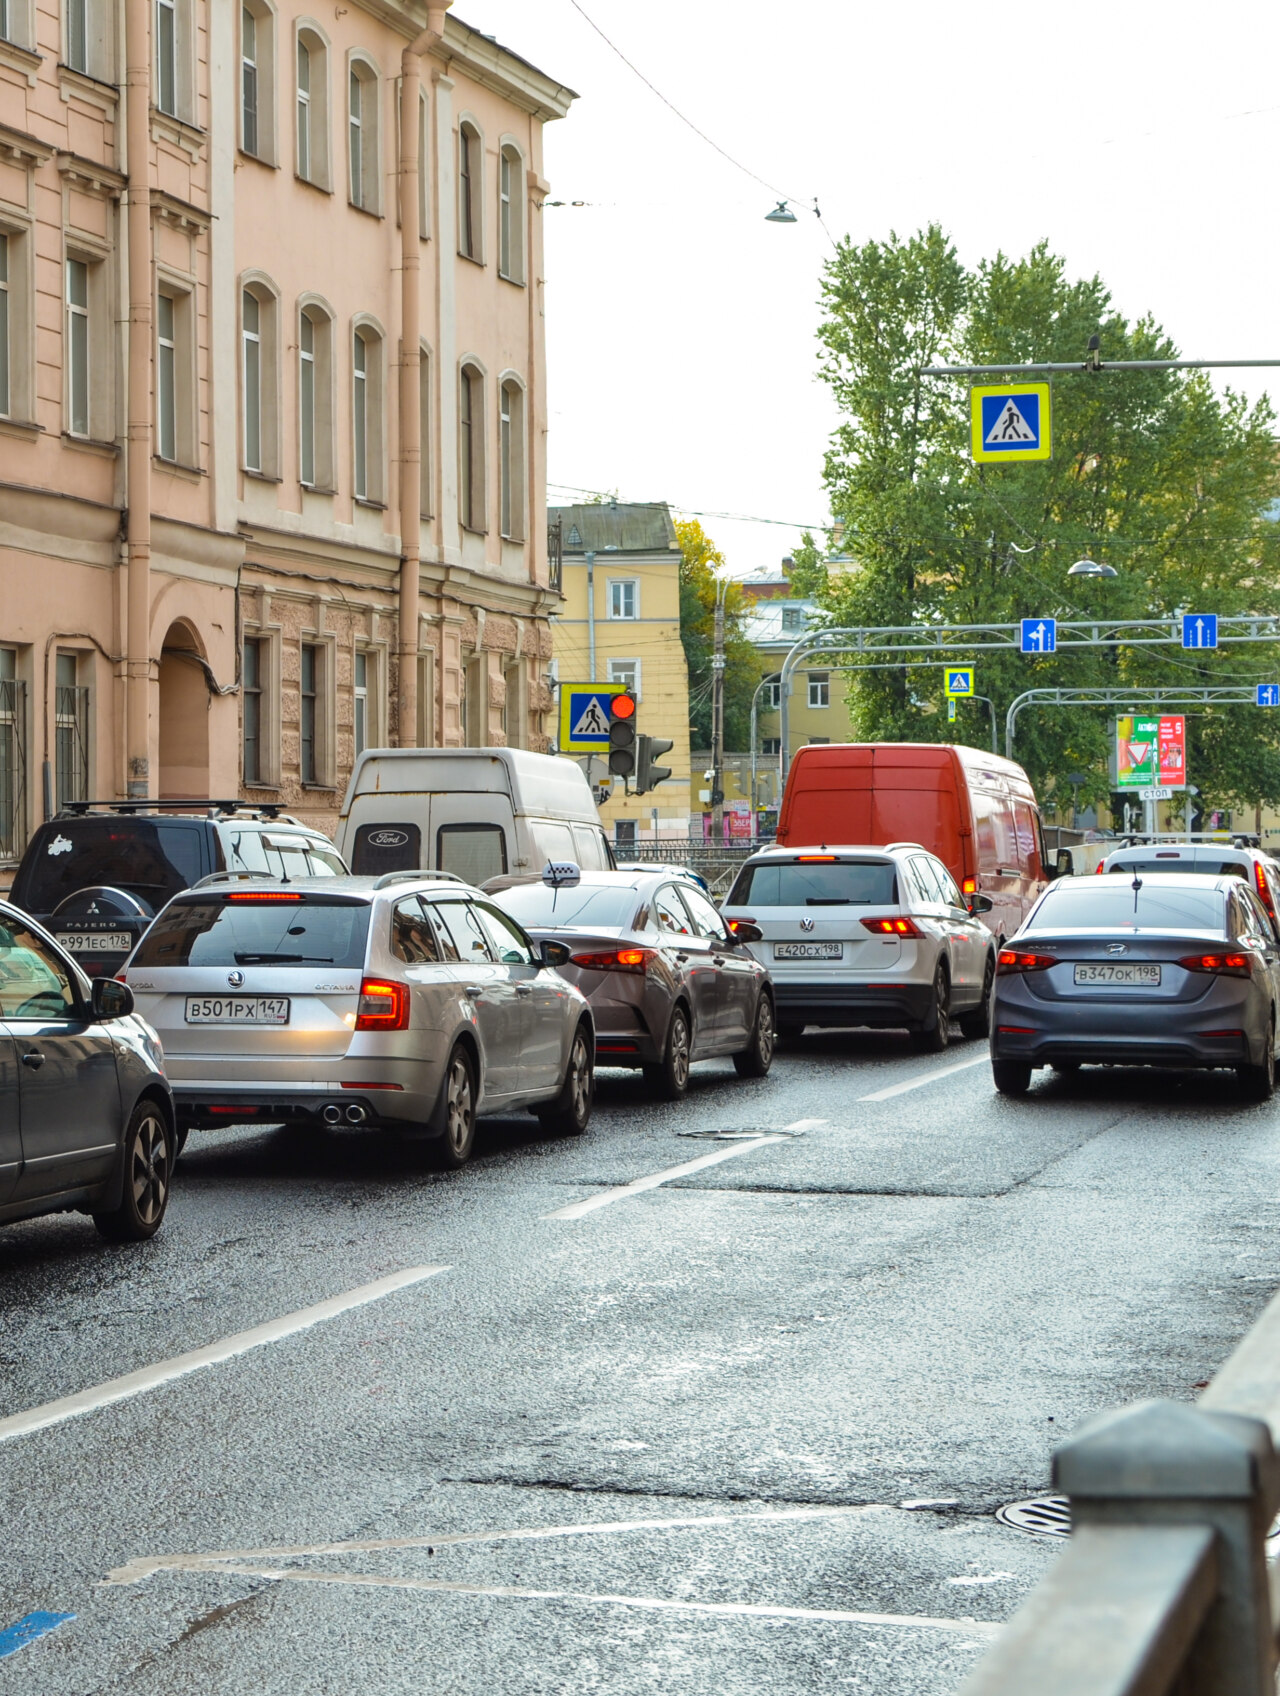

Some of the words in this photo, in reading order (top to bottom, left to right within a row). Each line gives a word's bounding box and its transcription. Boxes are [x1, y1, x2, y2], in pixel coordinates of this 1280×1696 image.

[1143, 789, 1168, 798] СТОП
[376, 832, 400, 844] Ford
[109, 935, 127, 945] 178
[778, 944, 821, 956] Е420СХ
[822, 944, 839, 952] 198
[1079, 966, 1133, 980] В347ОК
[1136, 967, 1156, 977] 198
[191, 1000, 255, 1017] В501РХ
[259, 1000, 284, 1014] 147
